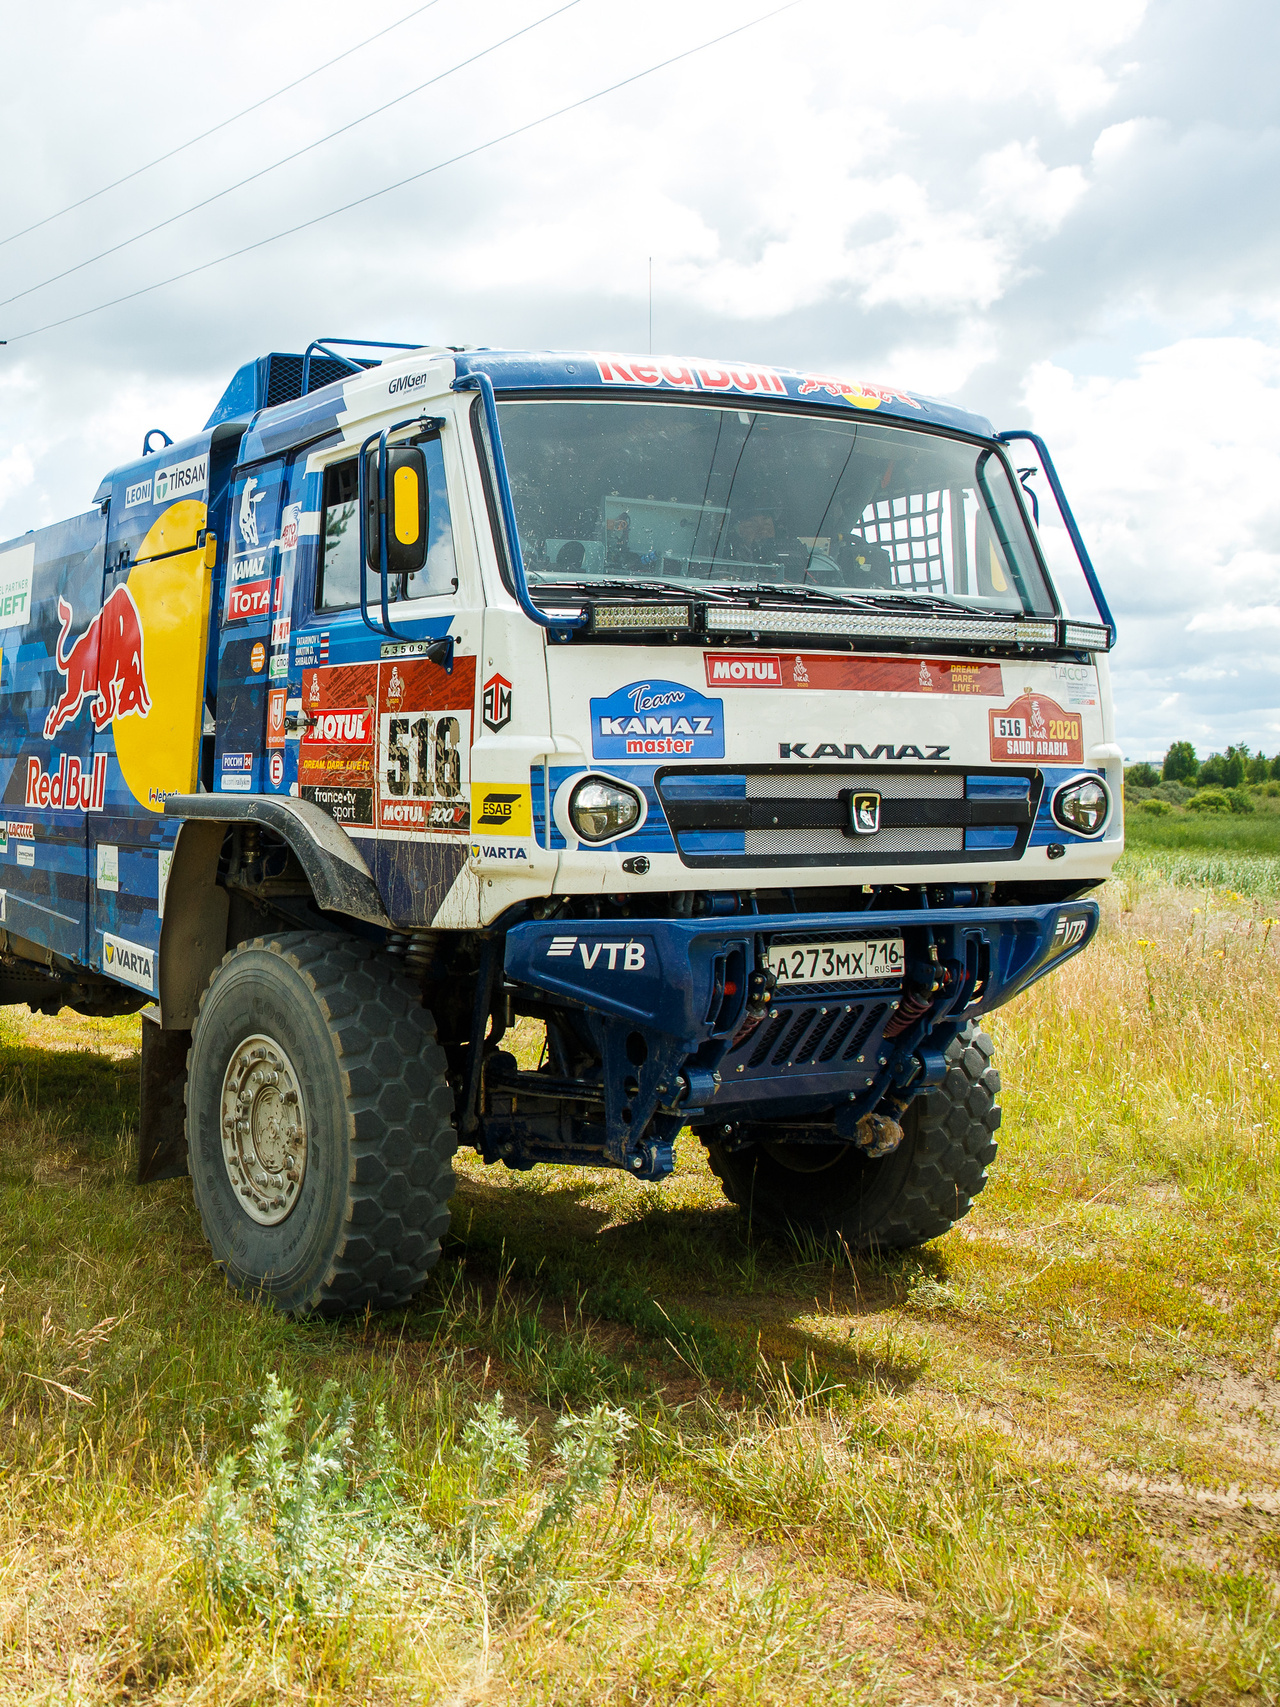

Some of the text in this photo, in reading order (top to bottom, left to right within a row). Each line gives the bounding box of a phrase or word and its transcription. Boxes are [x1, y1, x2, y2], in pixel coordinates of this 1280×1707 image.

[388, 373, 427, 394] GMGen
[126, 483, 151, 504] LEONI
[232, 556, 266, 581] KAMAZ
[5, 579, 29, 595] PARTNER
[232, 588, 281, 613] TOTAL
[384, 644, 423, 654] 43509
[713, 662, 777, 679] MOTUL
[950, 665, 980, 674] DREAM.
[952, 674, 975, 683] DARE.
[953, 684, 981, 692] LIVE IT.
[628, 685, 685, 713] Team
[309, 714, 366, 740] MOTUL
[599, 715, 714, 736] KAMAZ
[1000, 719, 1021, 737] 516
[1049, 720, 1079, 740] 2020
[626, 737, 694, 754] master
[778, 742, 951, 761] KAMAZ
[1006, 740, 1068, 756] SAUDI ARABIA
[387, 717, 461, 797] 516
[25, 753, 107, 811] Red Bull
[332, 805, 356, 821] sport
[383, 805, 466, 823] MOTUL 300V
[483, 803, 512, 815] ESAB
[8, 823, 33, 838] LOCTITE
[482, 845, 527, 860] VARTA
[1062, 920, 1087, 945] VTB
[116, 946, 152, 978] VARTA
[579, 943, 645, 971] VTB
[867, 942, 899, 966] 716
[874, 965, 890, 974] RUS
